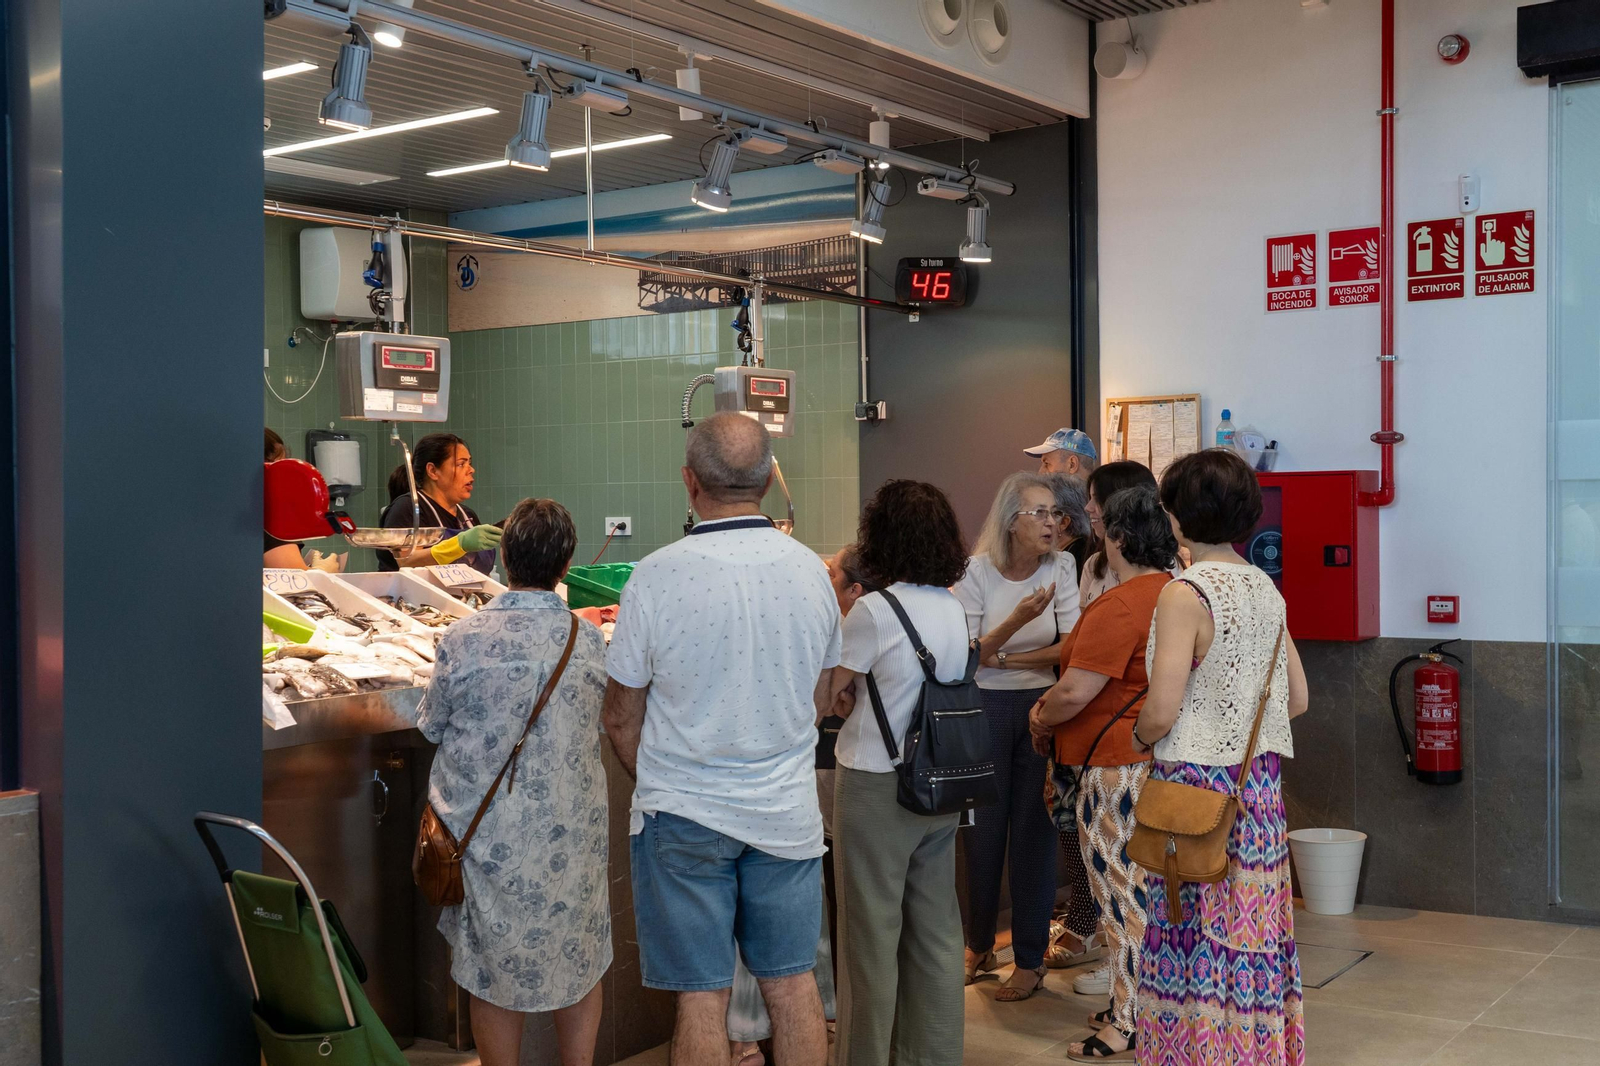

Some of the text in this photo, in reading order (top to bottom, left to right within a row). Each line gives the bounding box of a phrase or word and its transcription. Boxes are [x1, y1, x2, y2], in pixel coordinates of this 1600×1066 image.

[920, 258, 928, 267] Su
[1480, 271, 1529, 283] PULSADOR
[912, 272, 951, 298] 46
[1333, 285, 1375, 296] AVISADOR
[1411, 282, 1461, 294] EXTINTOR
[1478, 281, 1531, 294] DE ALARMA
[1271, 290, 1311, 301] BOCA DE
[1339, 294, 1369, 304] SONOR
[1270, 299, 1313, 310] INCENDIO
[260, 911, 283, 921] ROLSER
